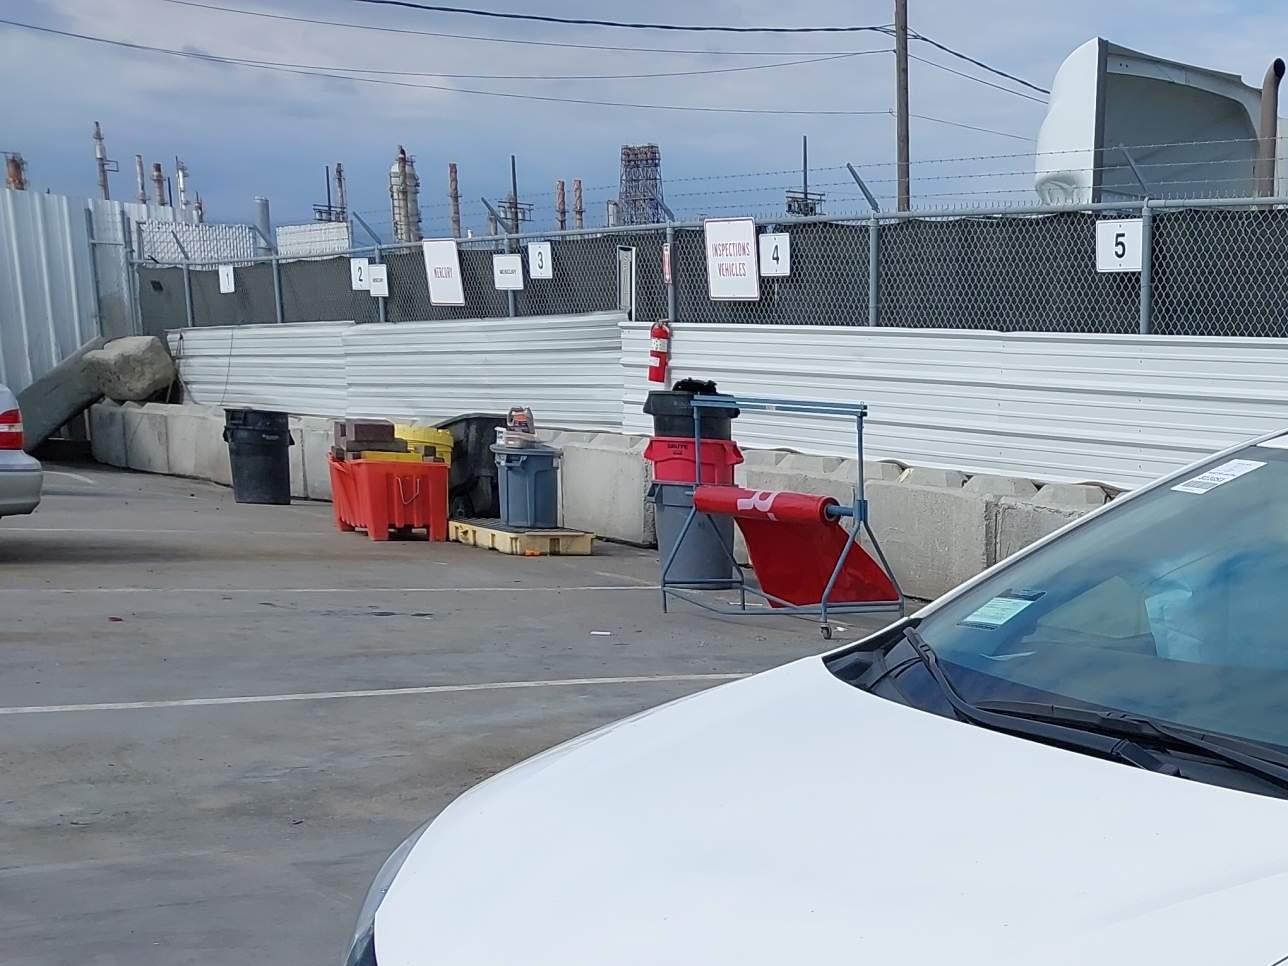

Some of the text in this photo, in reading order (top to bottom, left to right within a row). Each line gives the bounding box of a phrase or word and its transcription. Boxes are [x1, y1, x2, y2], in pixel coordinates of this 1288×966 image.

[711, 242, 750, 258] INSPECTIONS
[1114, 232, 1126, 259] 5
[537, 250, 544, 270] 3
[771, 244, 780, 266] 4
[357, 266, 364, 283] 2
[717, 262, 747, 278] VEHICLES
